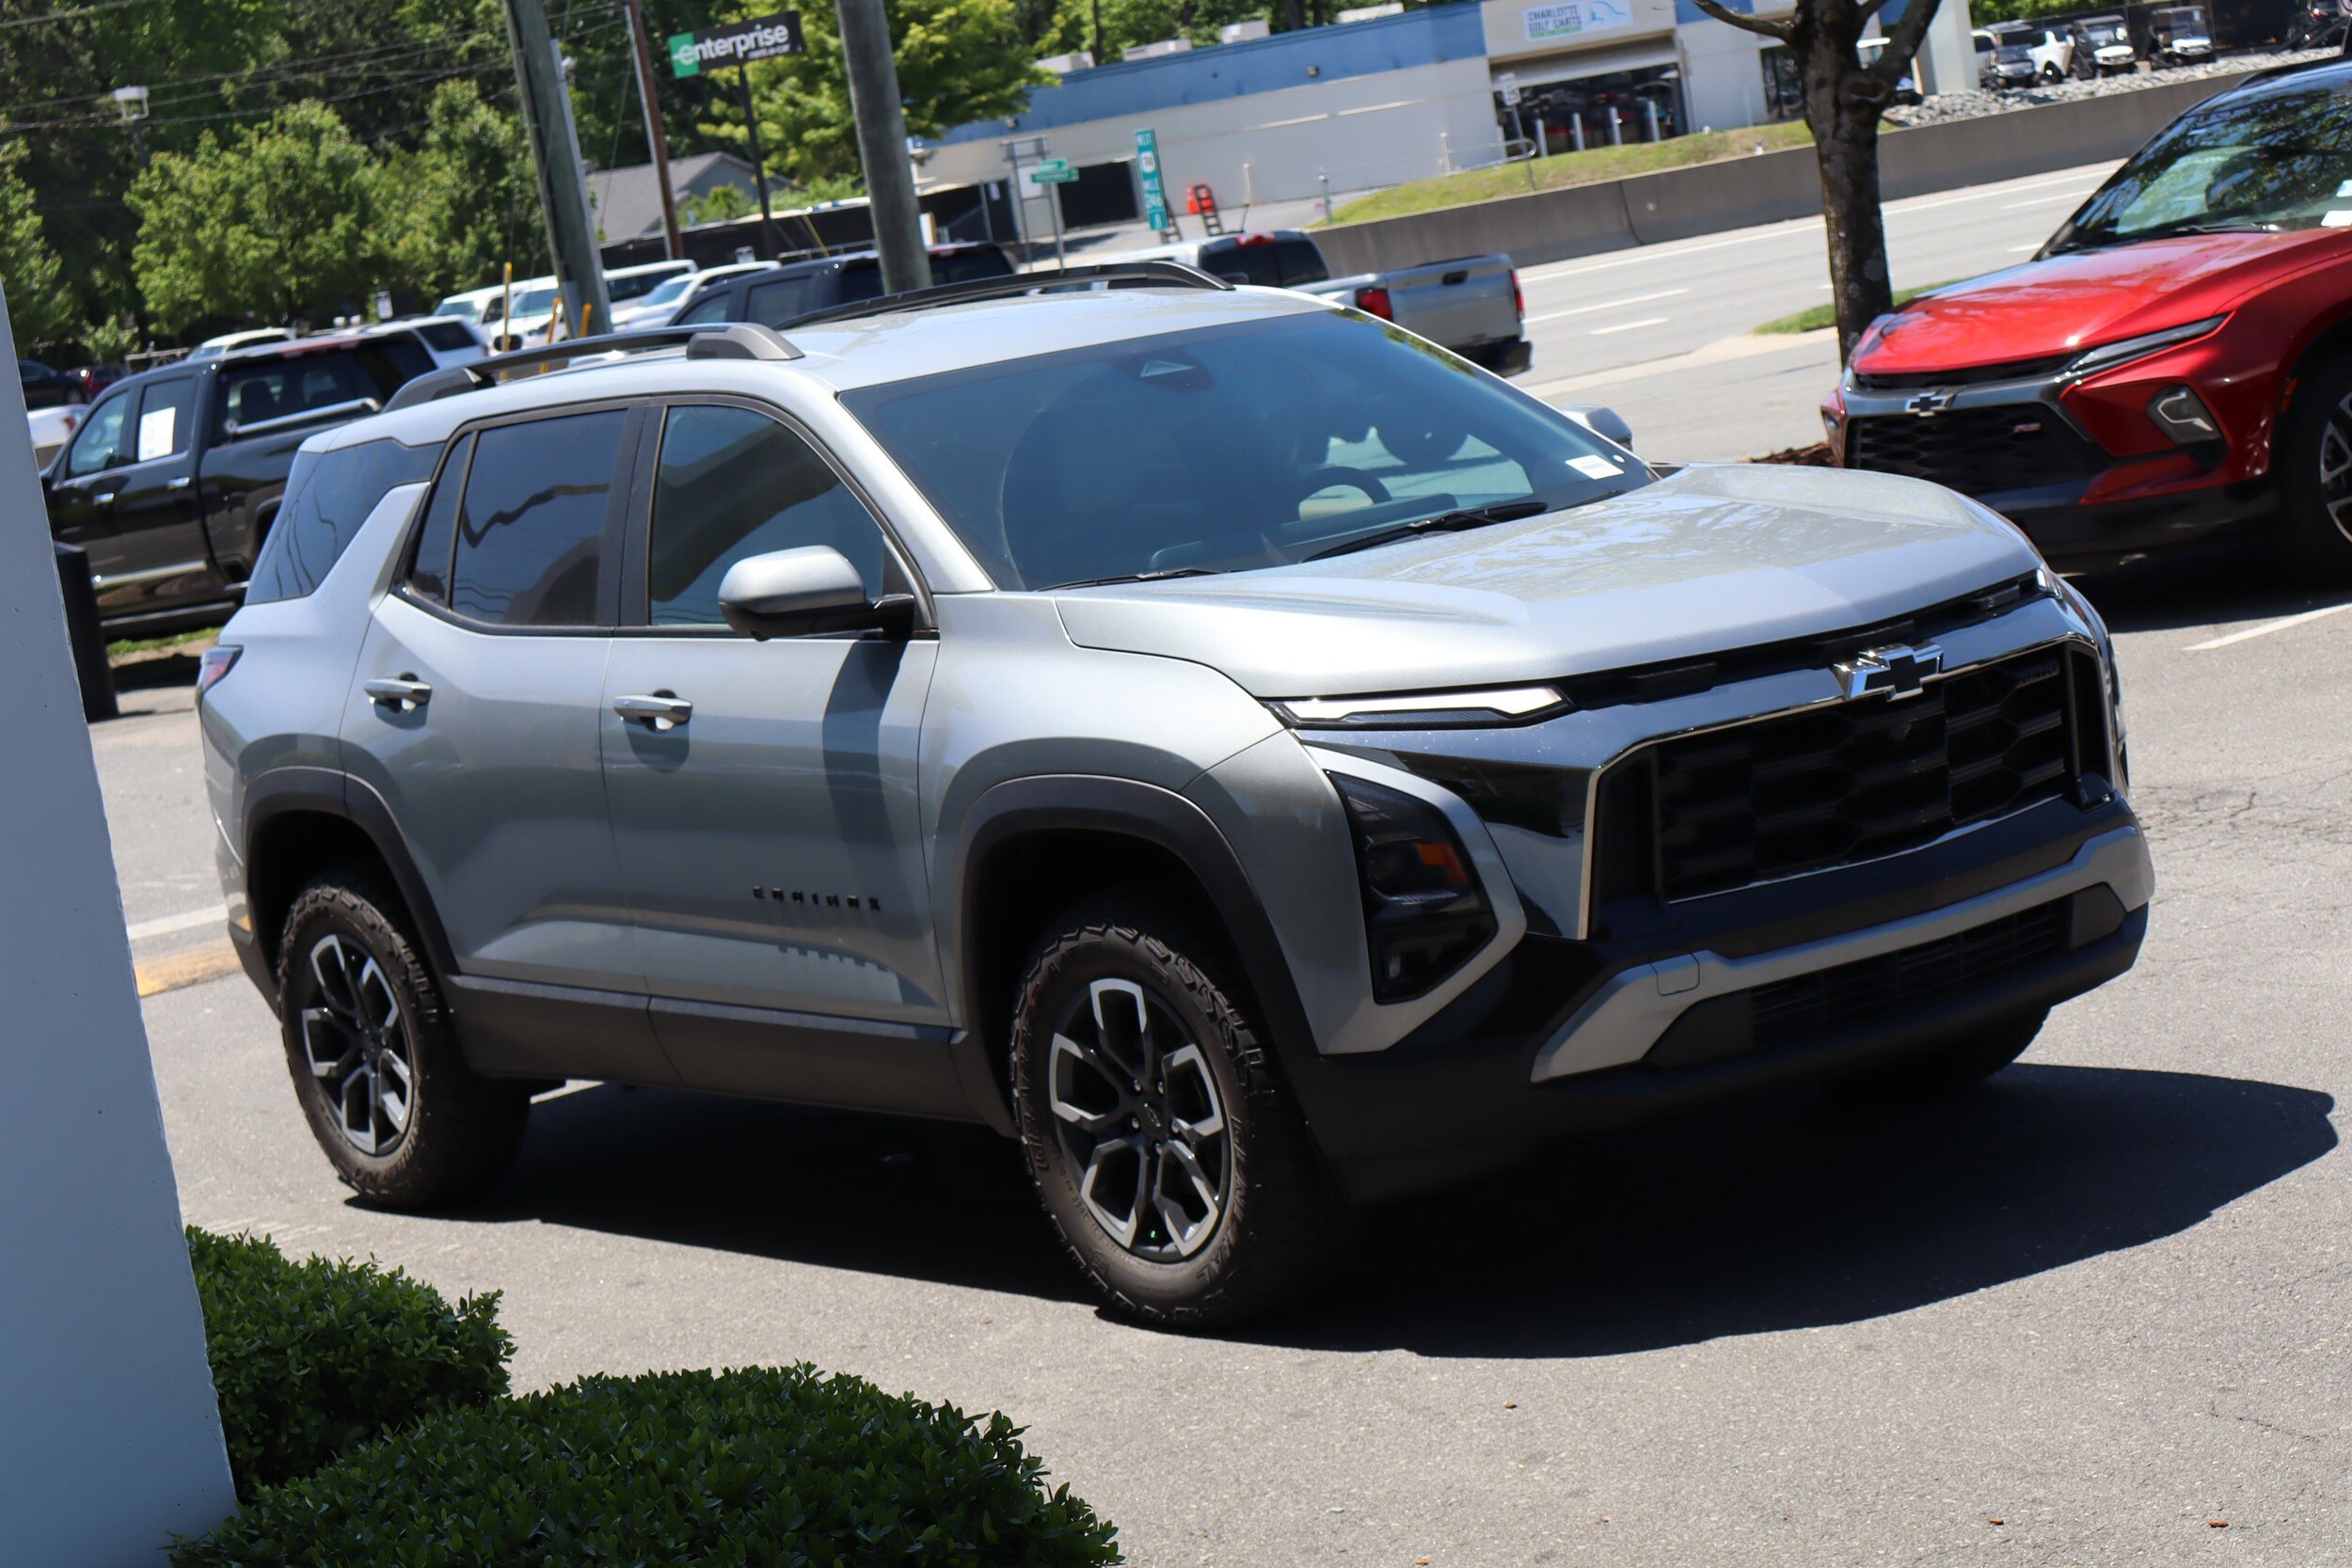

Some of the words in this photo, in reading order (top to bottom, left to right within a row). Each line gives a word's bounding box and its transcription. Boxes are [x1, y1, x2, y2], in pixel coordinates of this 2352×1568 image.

[1528, 4, 1579, 21] CHARLOTTE
[1529, 19, 1550, 32] GOLF
[1554, 15, 1582, 30] CARTS
[672, 24, 789, 66] enterprise
